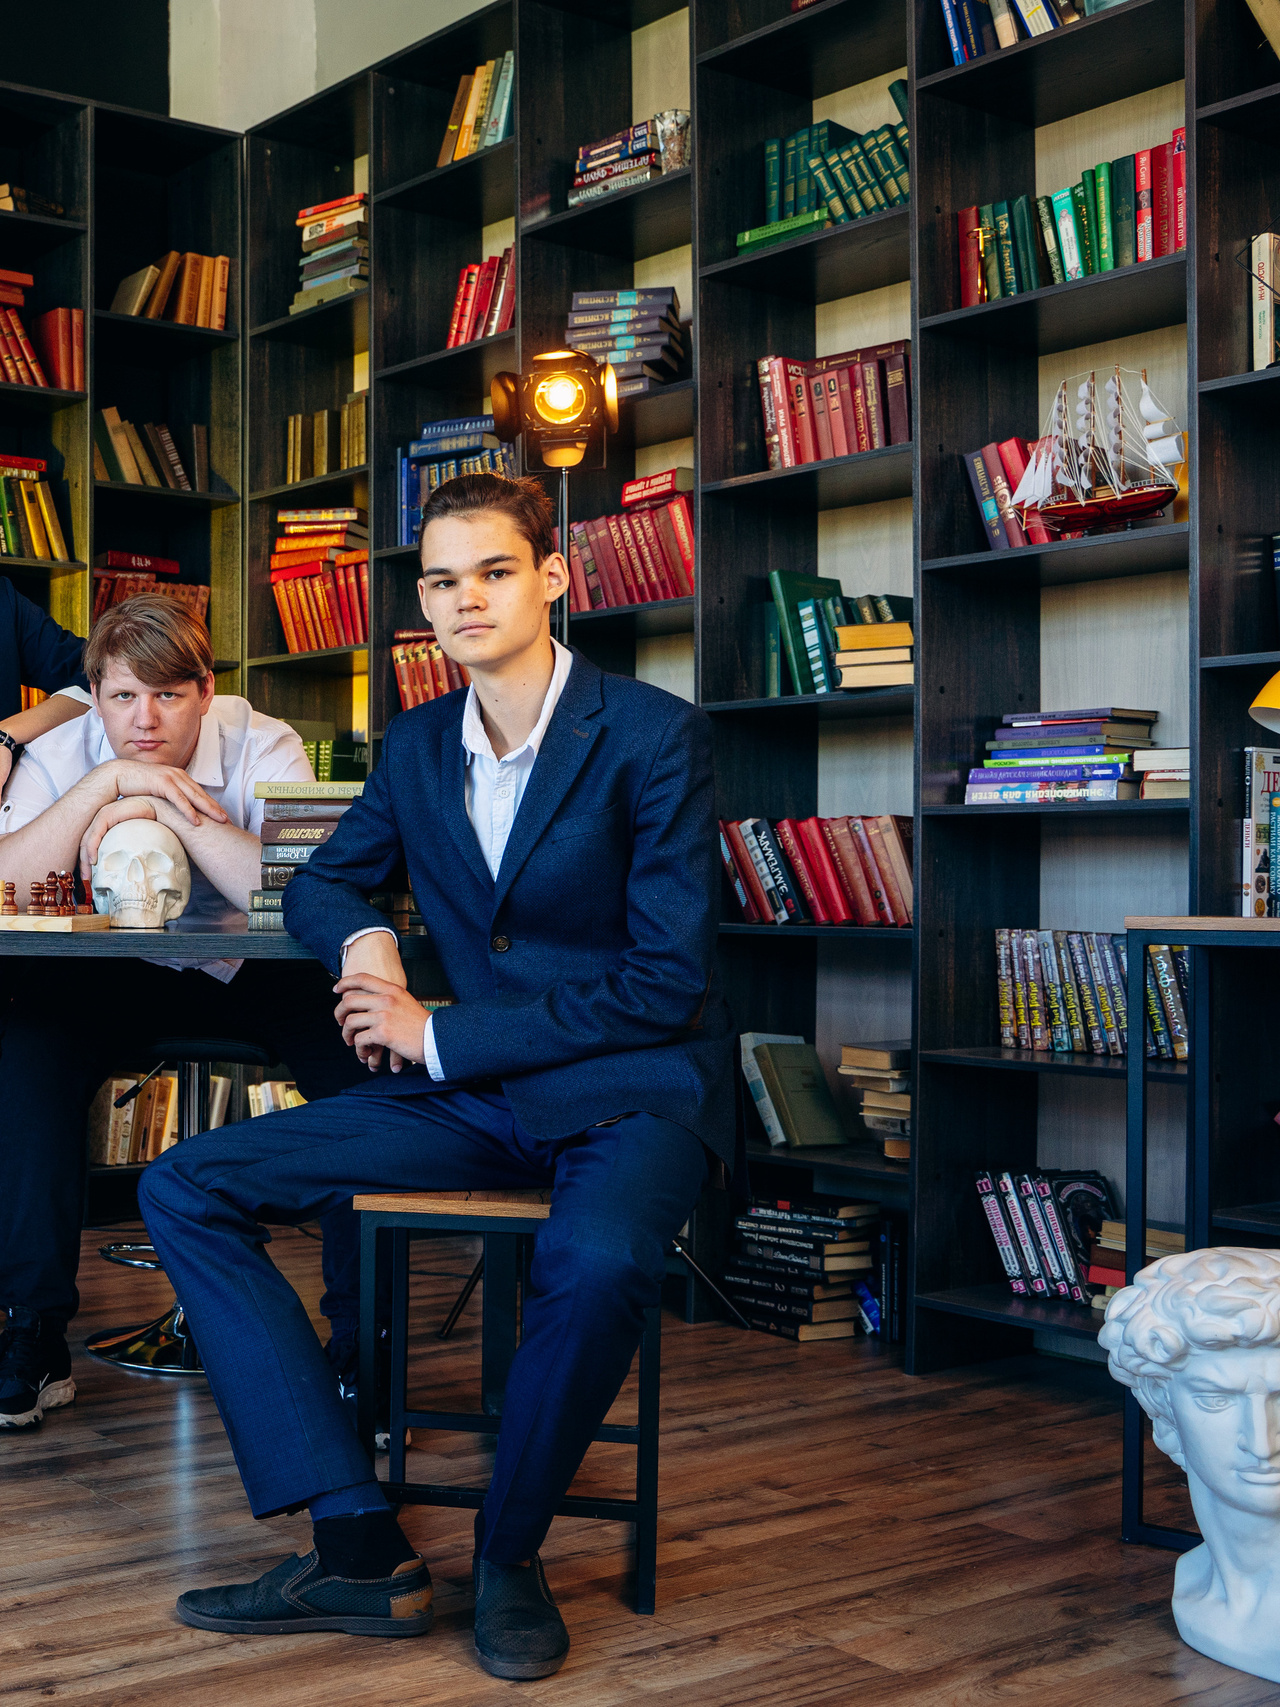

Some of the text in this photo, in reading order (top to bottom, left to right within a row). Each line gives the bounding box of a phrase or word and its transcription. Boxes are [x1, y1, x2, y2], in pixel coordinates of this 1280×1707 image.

[266, 785, 325, 795] ЖИВОТНЫХ
[1025, 787, 1104, 800] ЭНЦИКЛОПЕДИЯ
[971, 791, 1000, 801] ДЕТЕЙ
